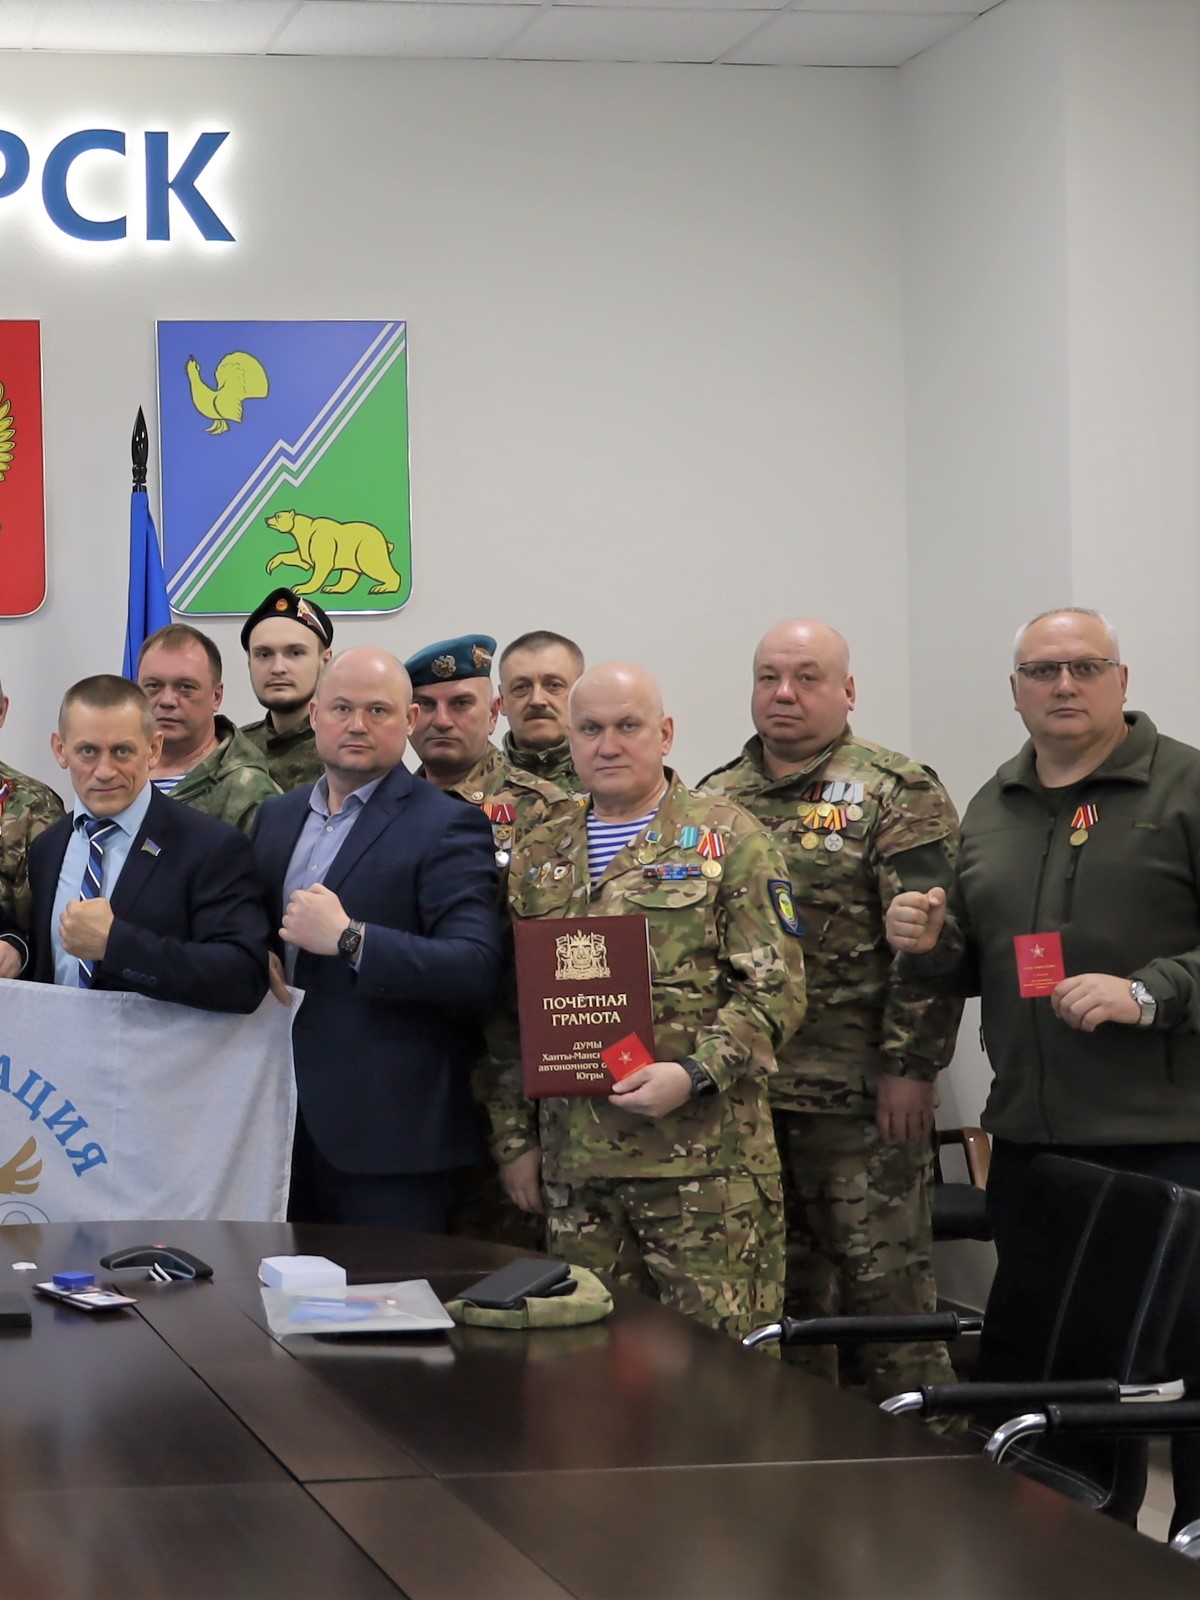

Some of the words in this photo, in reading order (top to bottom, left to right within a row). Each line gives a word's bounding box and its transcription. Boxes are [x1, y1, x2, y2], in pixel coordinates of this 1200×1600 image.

[543, 993, 627, 1010] ПОЧЁТНАЯ
[552, 1012, 621, 1026] ГРАМОТА
[572, 1041, 602, 1050] ДУМЫ
[538, 1062, 599, 1072] автономного
[576, 1071, 604, 1081] Югры
